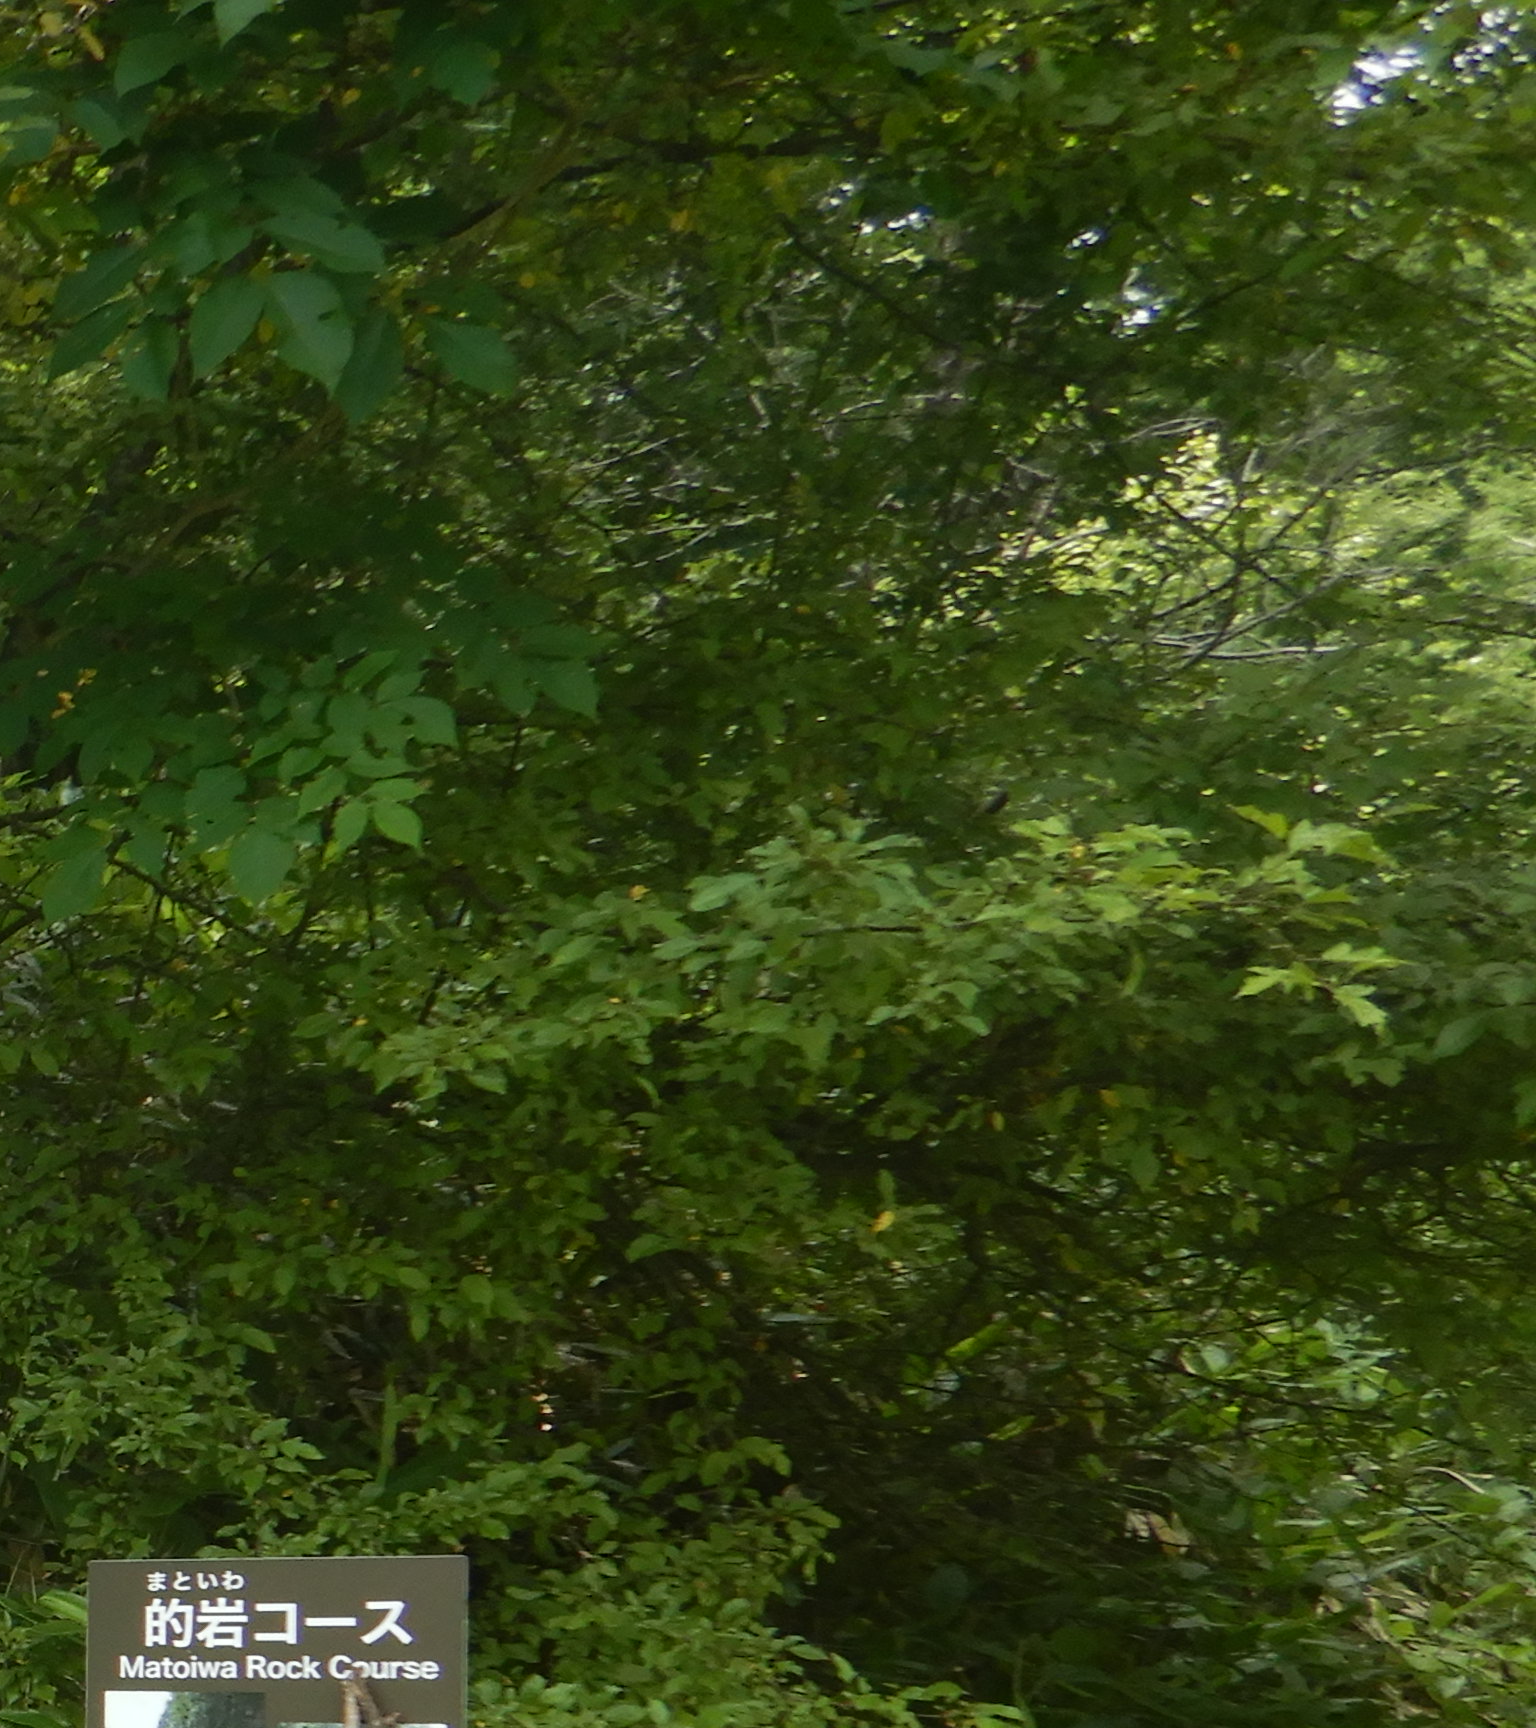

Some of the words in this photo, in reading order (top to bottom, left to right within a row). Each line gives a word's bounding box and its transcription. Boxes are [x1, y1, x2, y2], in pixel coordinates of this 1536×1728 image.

[146, 1570, 246, 1593] まといわ
[143, 1596, 414, 1649] 的岩コース
[119, 1655, 238, 1680] Matoiwa
[245, 1655, 321, 1680] Rock
[329, 1654, 440, 1680] Course
